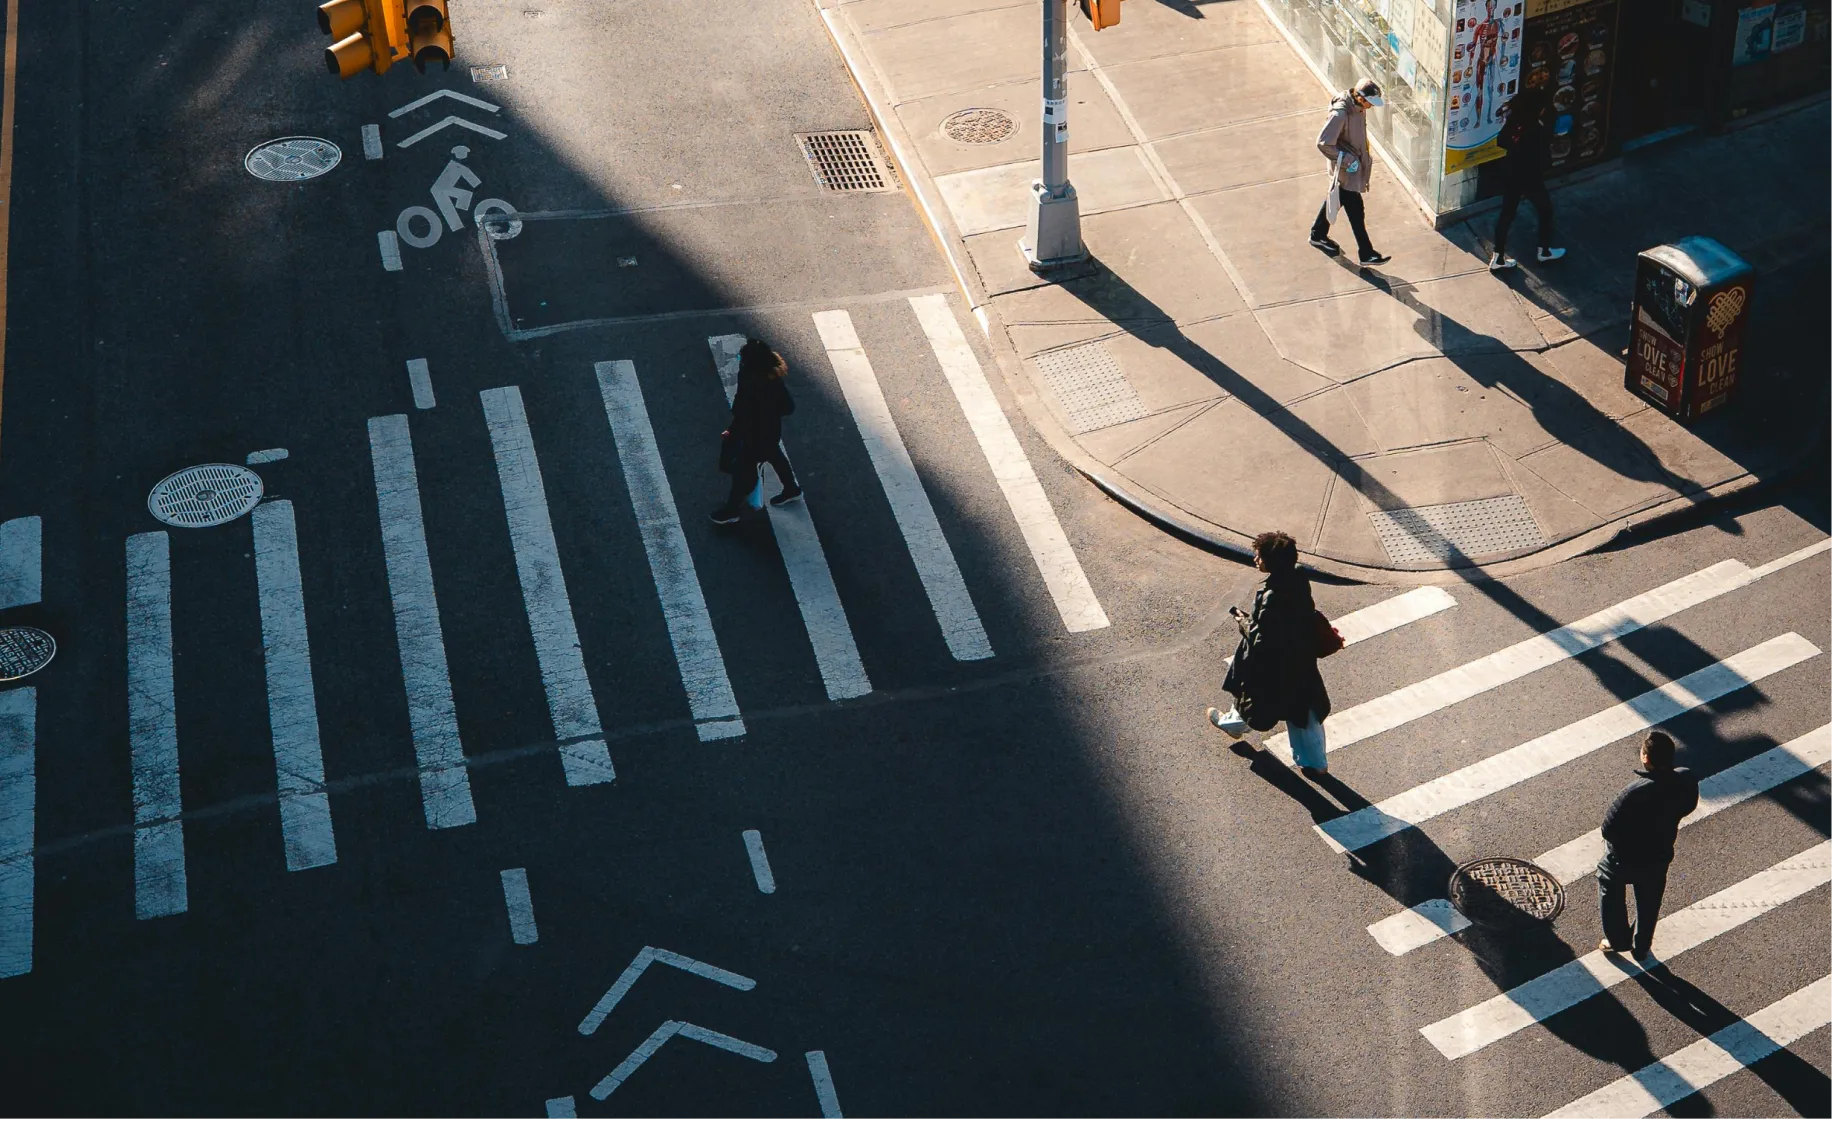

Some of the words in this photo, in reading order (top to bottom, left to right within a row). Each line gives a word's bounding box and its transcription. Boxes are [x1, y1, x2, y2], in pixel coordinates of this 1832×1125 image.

[1637, 339, 1667, 371] LOVE
[1701, 341, 1724, 362] SHOW
[1645, 362, 1666, 382] CLEAN
[1698, 349, 1738, 387] LOVE
[1710, 373, 1735, 394] CLEAN
